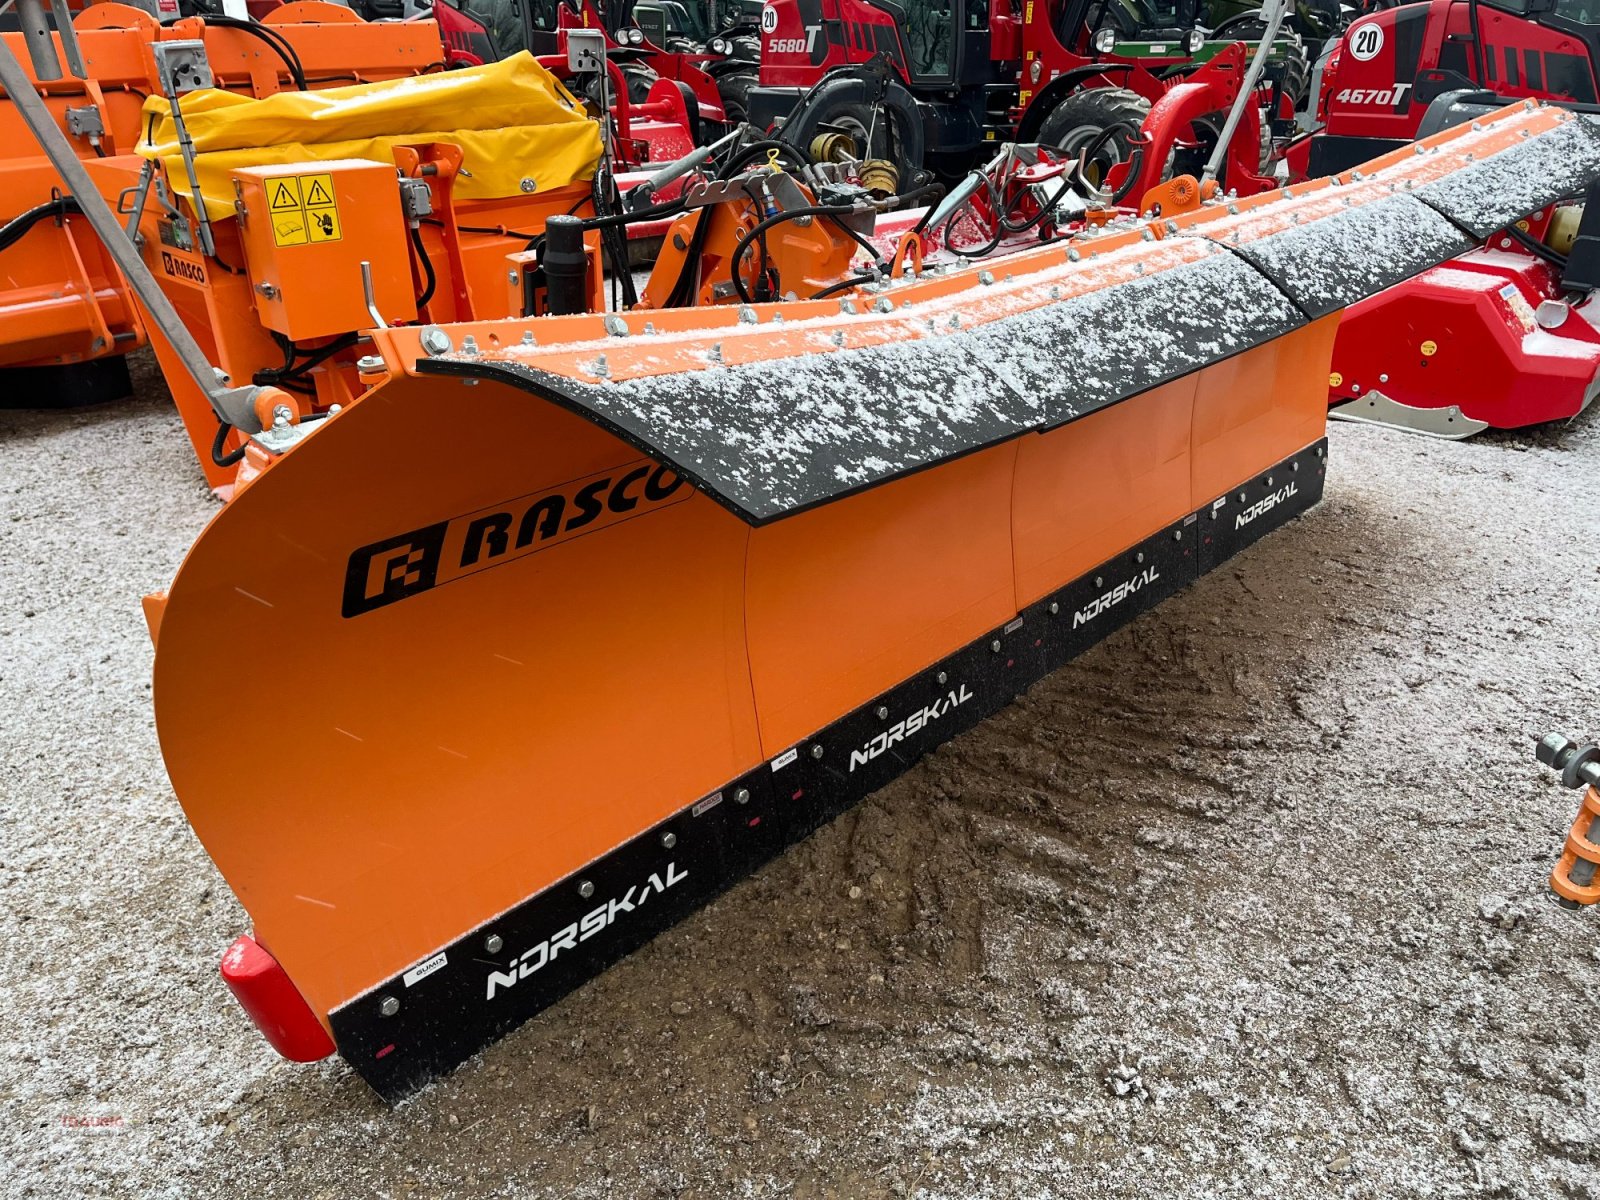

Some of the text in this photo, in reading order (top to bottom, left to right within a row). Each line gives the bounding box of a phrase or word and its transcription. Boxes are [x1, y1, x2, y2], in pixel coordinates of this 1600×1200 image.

[764, 11, 775, 28] 20
[768, 25, 822, 53] 5680T
[1356, 30, 1378, 54] 20
[1336, 83, 1413, 106] 4670T
[174, 258, 205, 284] RASCO
[459, 464, 687, 568] RASCO
[1072, 566, 1160, 630] NORSKAL
[848, 683, 974, 772] NORSKAL
[486, 862, 689, 1000] NORSKAL
[416, 955, 445, 977] GUMIX
